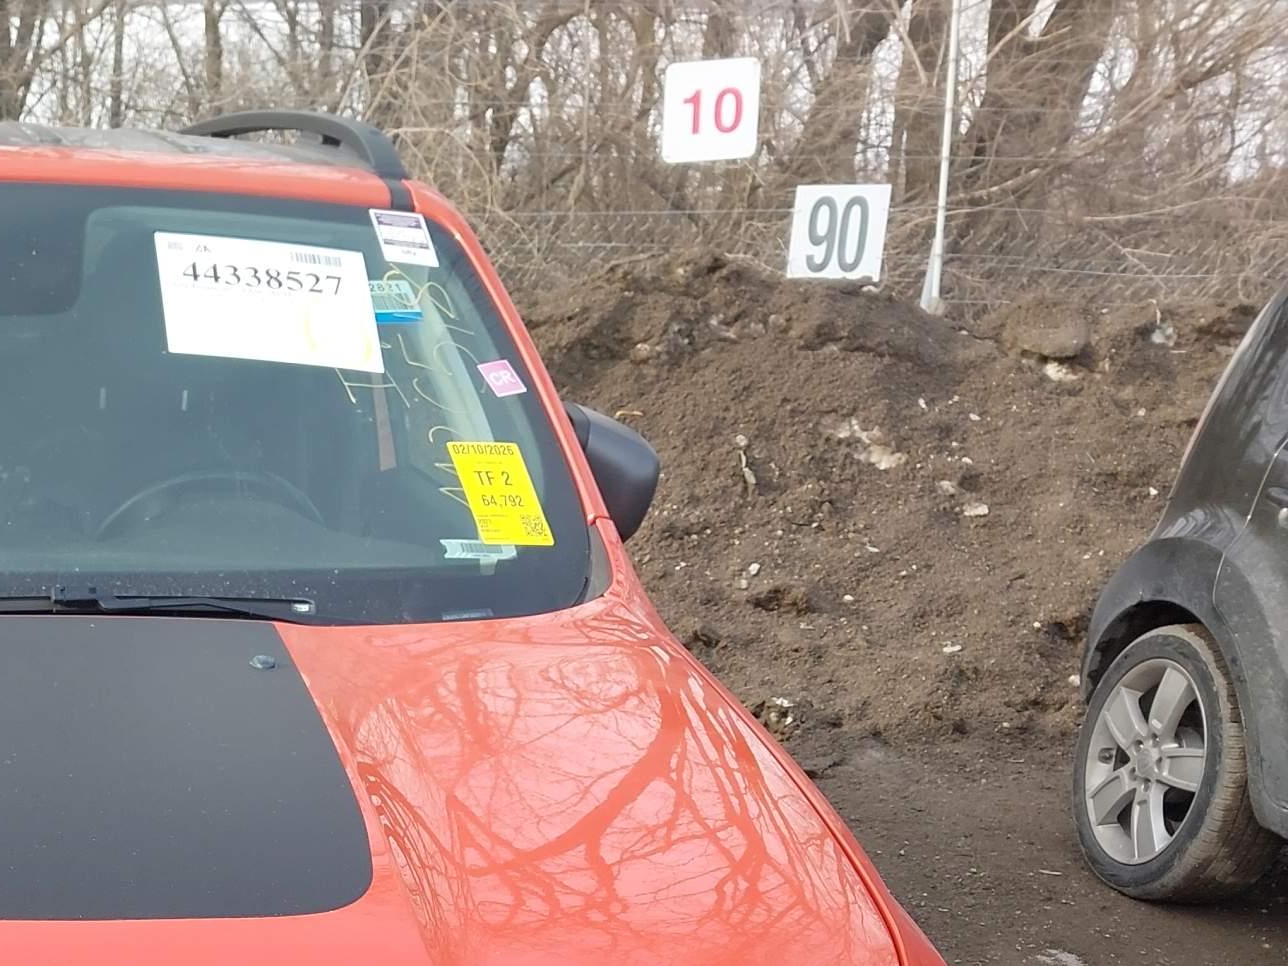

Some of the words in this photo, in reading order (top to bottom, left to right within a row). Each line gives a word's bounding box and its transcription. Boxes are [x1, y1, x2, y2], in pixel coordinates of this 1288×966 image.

[682, 87, 744, 136] 10
[805, 195, 870, 274] 90
[182, 261, 342, 295] 44338527
[488, 370, 517, 386] CR
[452, 443, 515, 456] 02/10/2026
[473, 470, 496, 486] TF
[501, 470, 513, 486] 2
[481, 494, 526, 508] 64,792
